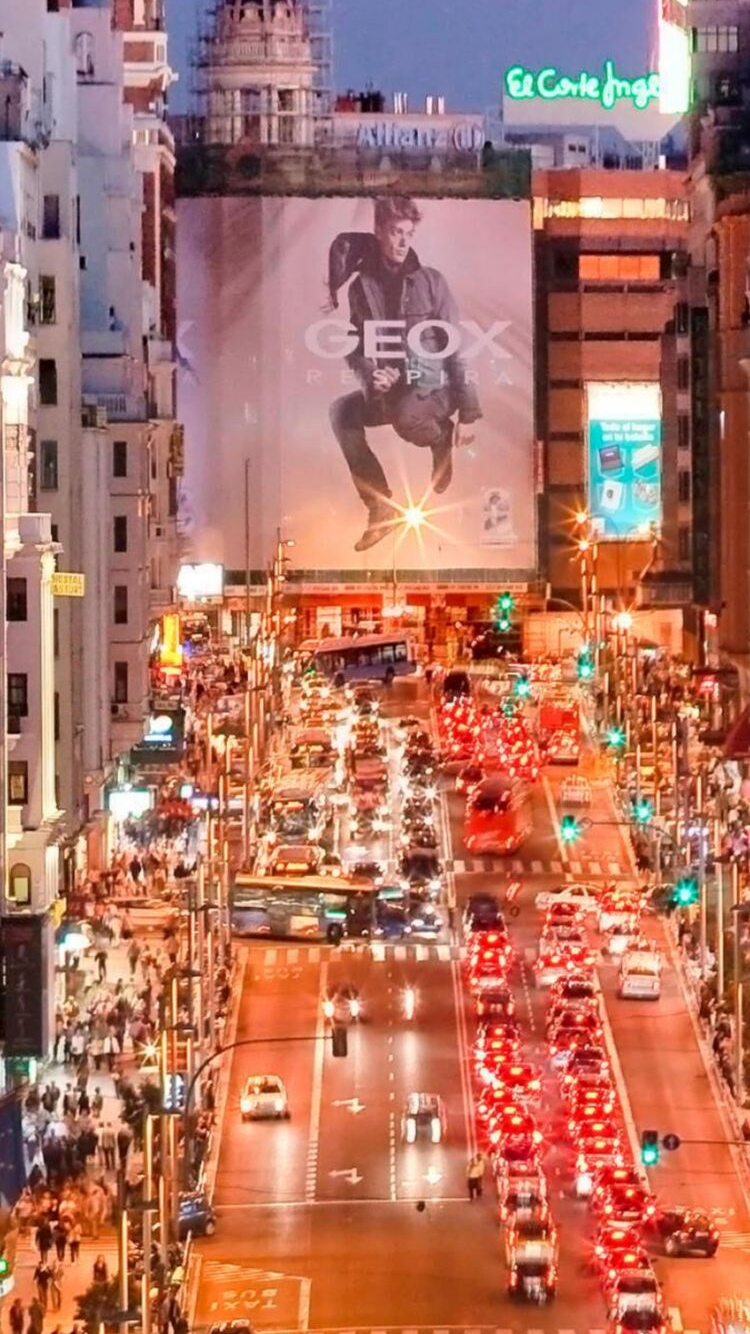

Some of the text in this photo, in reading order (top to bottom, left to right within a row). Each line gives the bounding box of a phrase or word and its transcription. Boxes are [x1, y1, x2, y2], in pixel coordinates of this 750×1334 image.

[505, 59, 660, 109] El Corte Ingl
[356, 123, 449, 147] Allianz
[304, 319, 513, 359] GEOX
[306, 369, 514, 386] RESPIRA
[210, 1299, 278, 1312] TAXI
